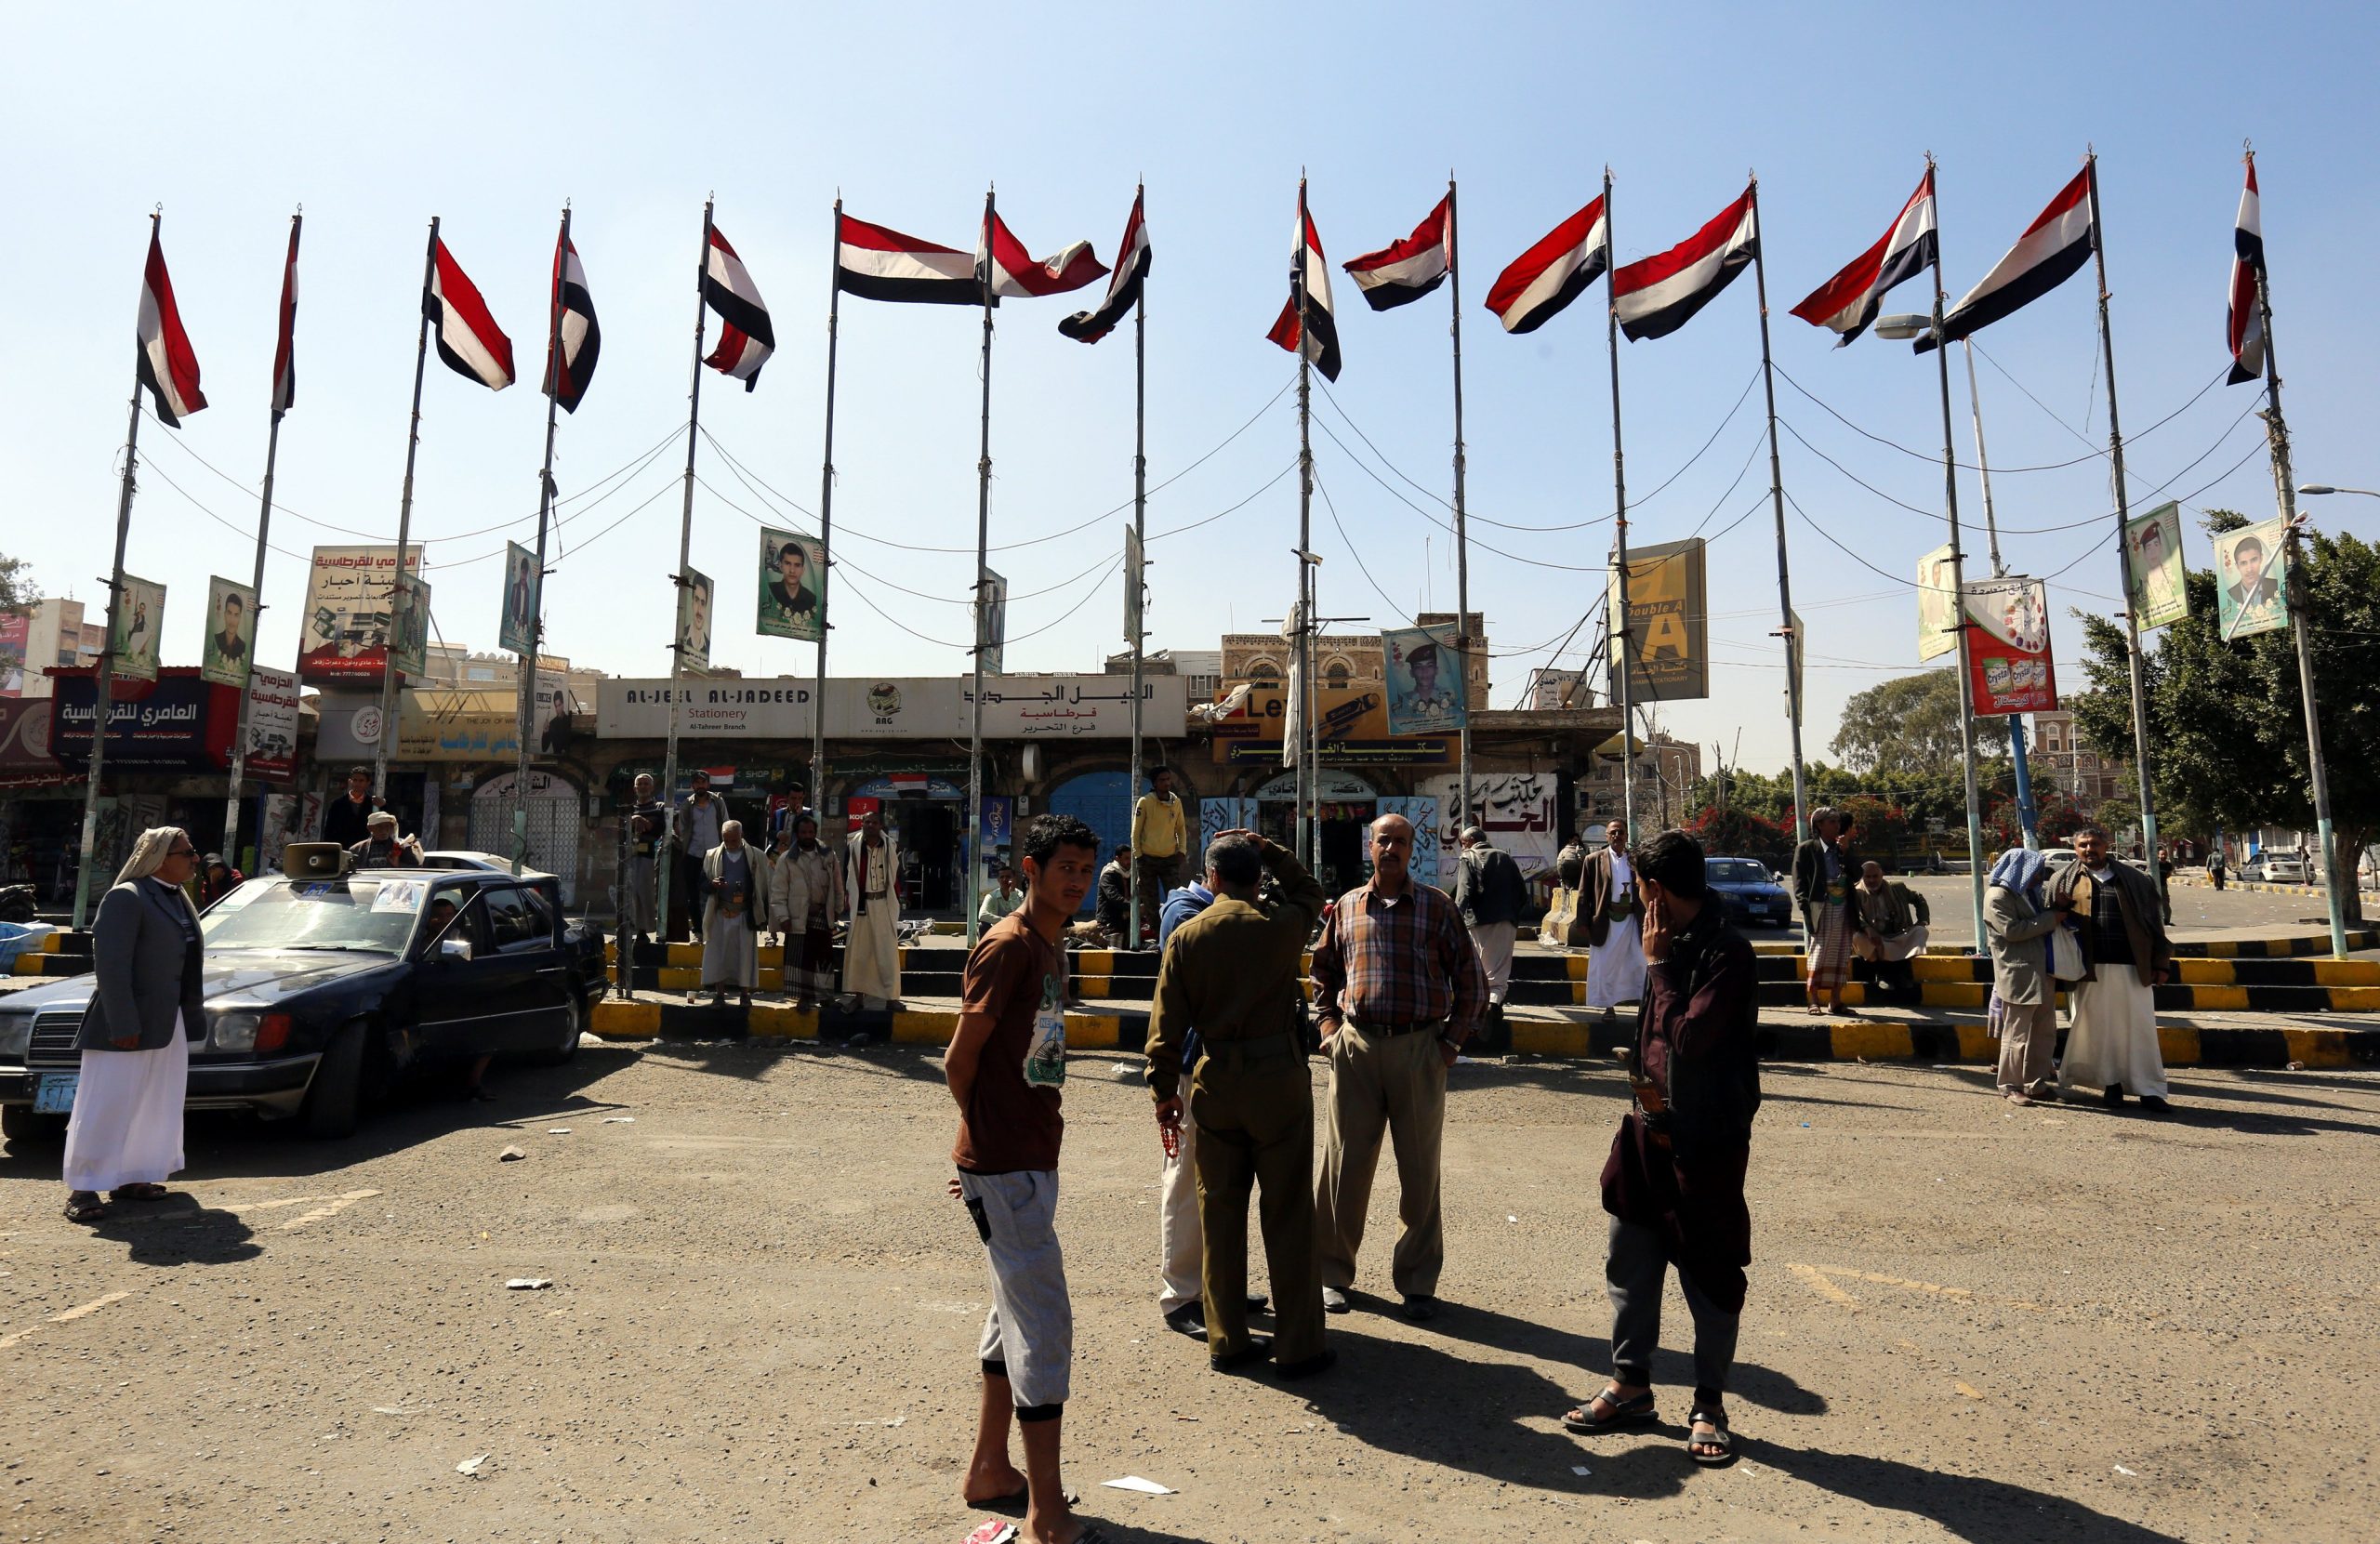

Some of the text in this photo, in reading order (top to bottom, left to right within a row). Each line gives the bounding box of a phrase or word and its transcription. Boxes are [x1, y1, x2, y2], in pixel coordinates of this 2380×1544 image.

[315, 556, 416, 569] المي للقرطاسية
[321, 573, 360, 589] أحبار
[1988, 670, 2009, 684] Crystal
[250, 689, 299, 708] للقرطاسية
[708, 690, 810, 704] AL-JADEED
[964, 684, 1064, 705] الجديد
[62, 704, 196, 726] العامري للقراسية
[688, 708, 747, 720] Stationery
[1020, 707, 1097, 719] قرطاسية
[1022, 722, 1096, 734] فرع التحرير
[1340, 741, 1446, 758] مكتبة
[0, 772, 61, 788] للقرطاسي
[746, 770, 770, 778] SHOP
[1440, 797, 1555, 851] الخاي
